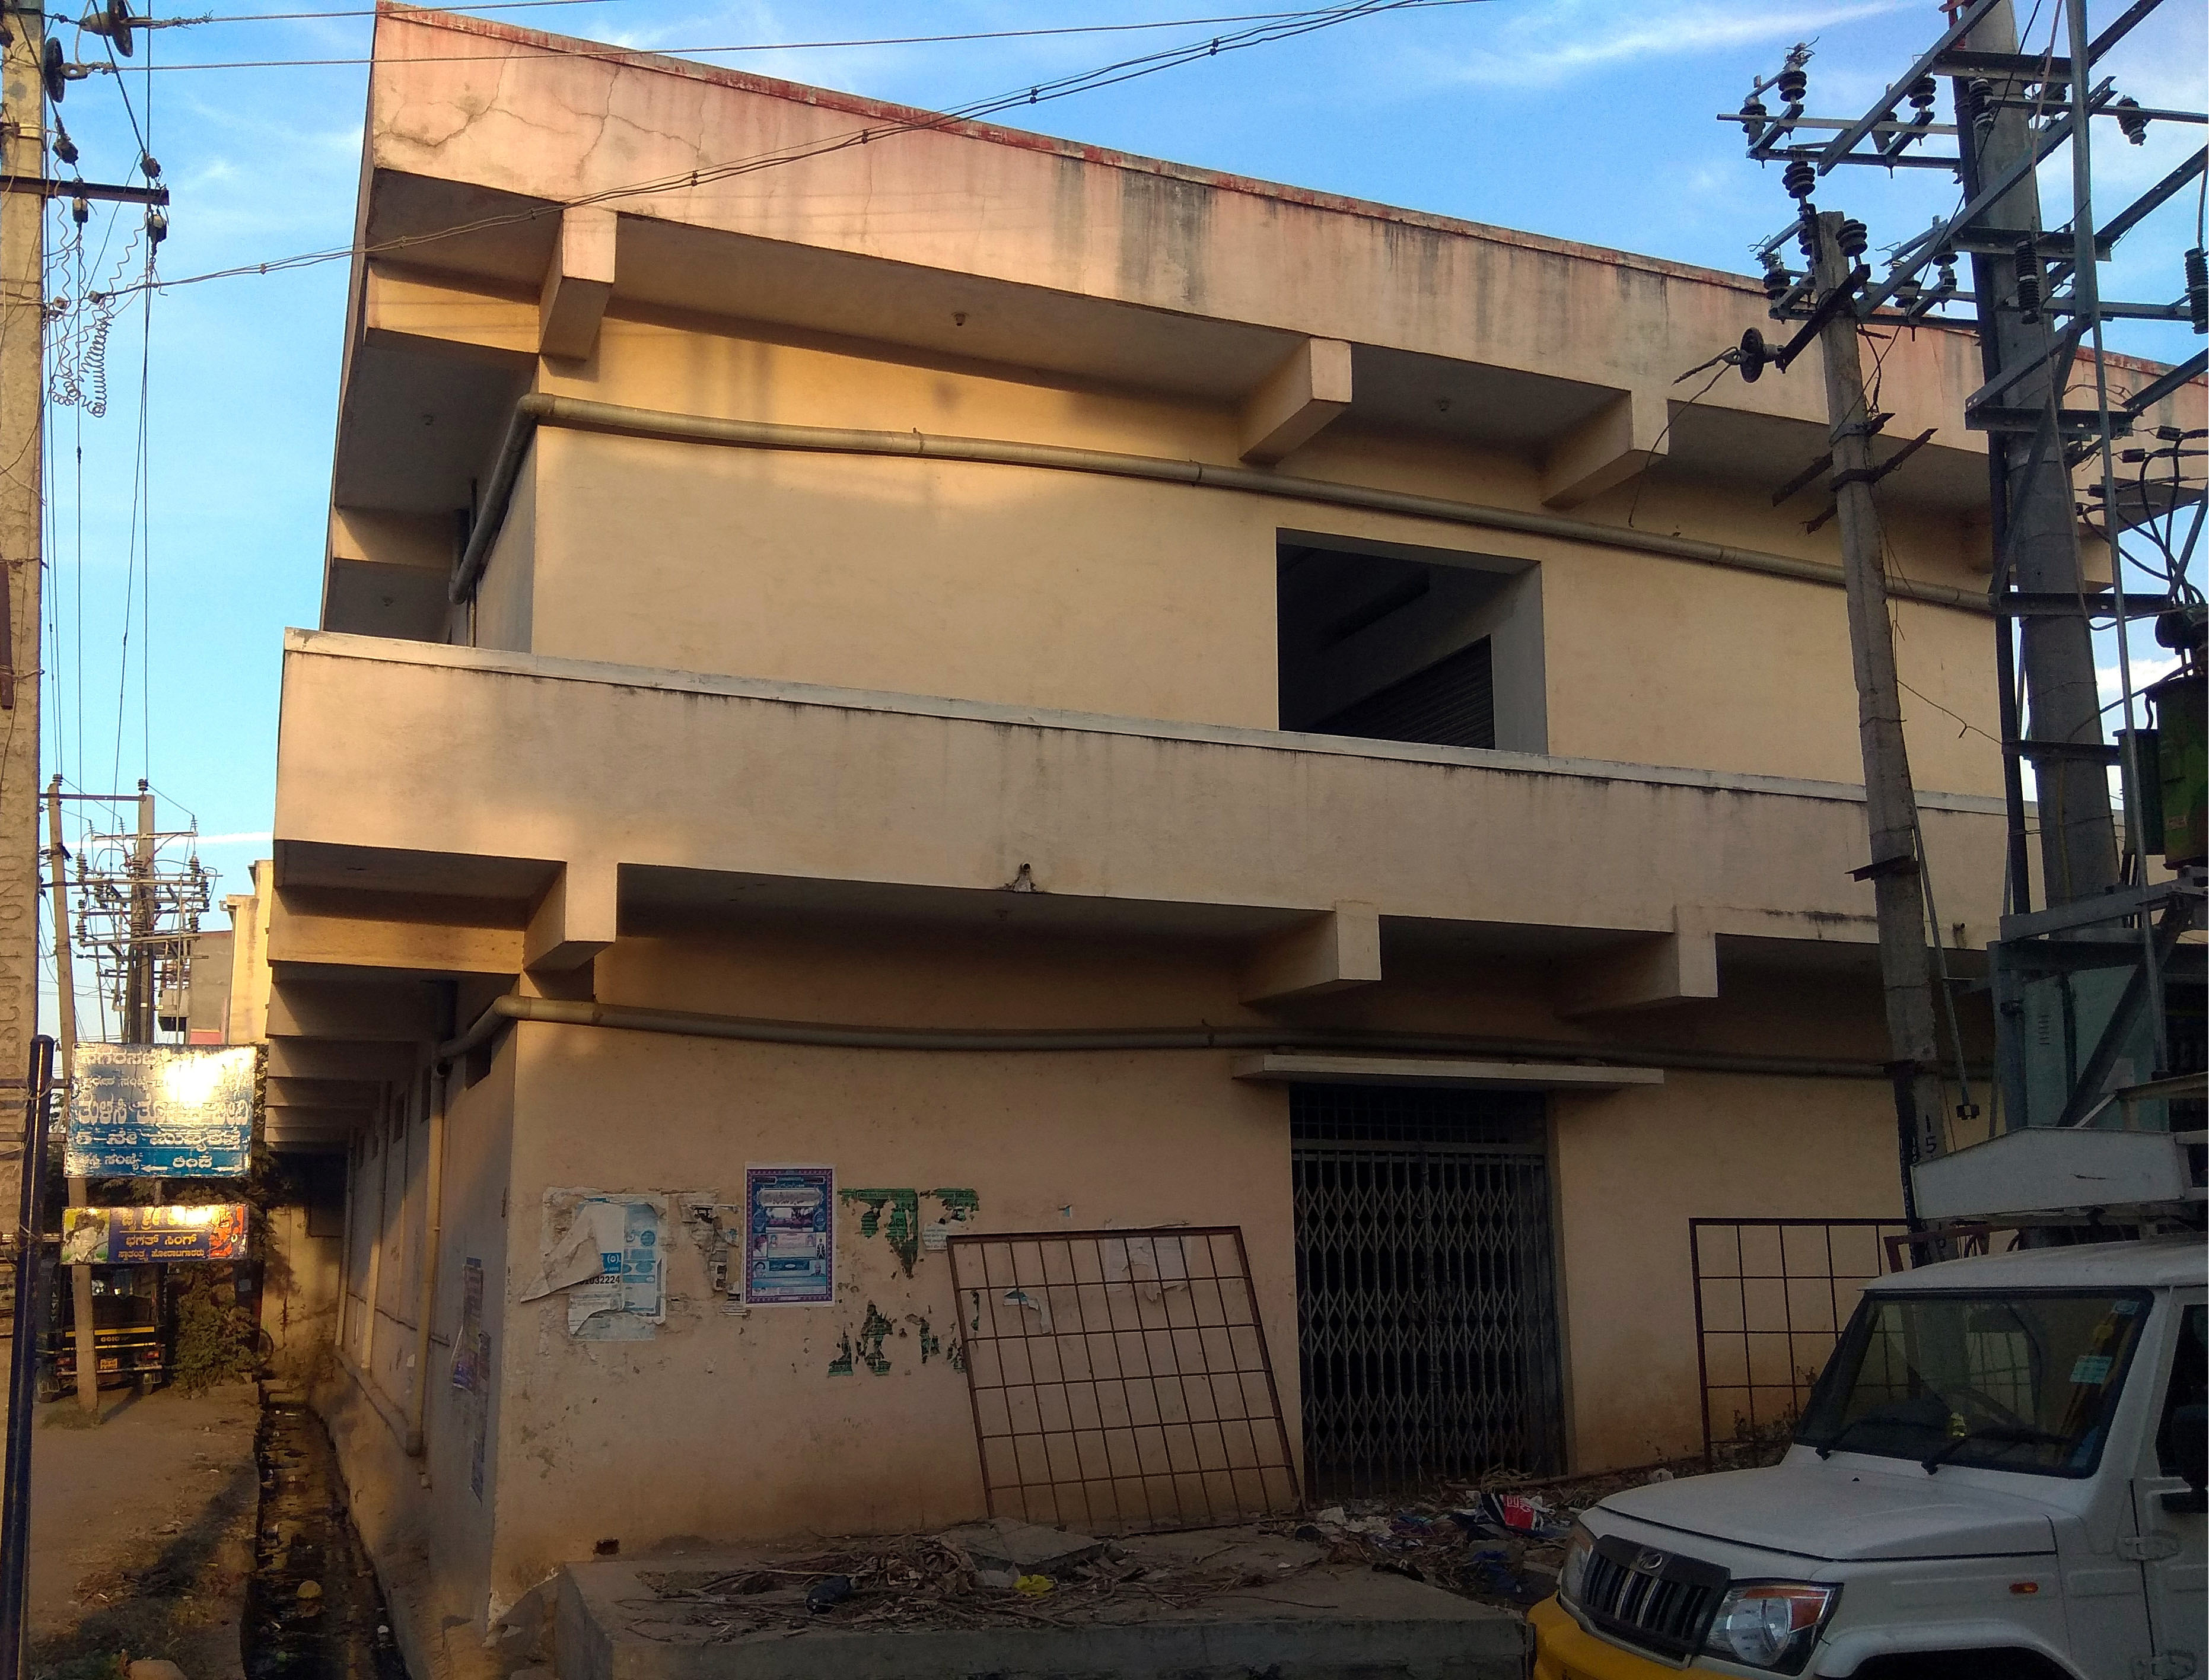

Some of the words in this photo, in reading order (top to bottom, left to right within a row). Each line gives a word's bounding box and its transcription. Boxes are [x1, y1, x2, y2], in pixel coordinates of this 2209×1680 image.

[78, 1093, 127, 1125] ತುಳಸಿ
[125, 1234, 159, 1248] ಭಗತ್
[164, 1233, 197, 1246] ಸಿಂಗ್
